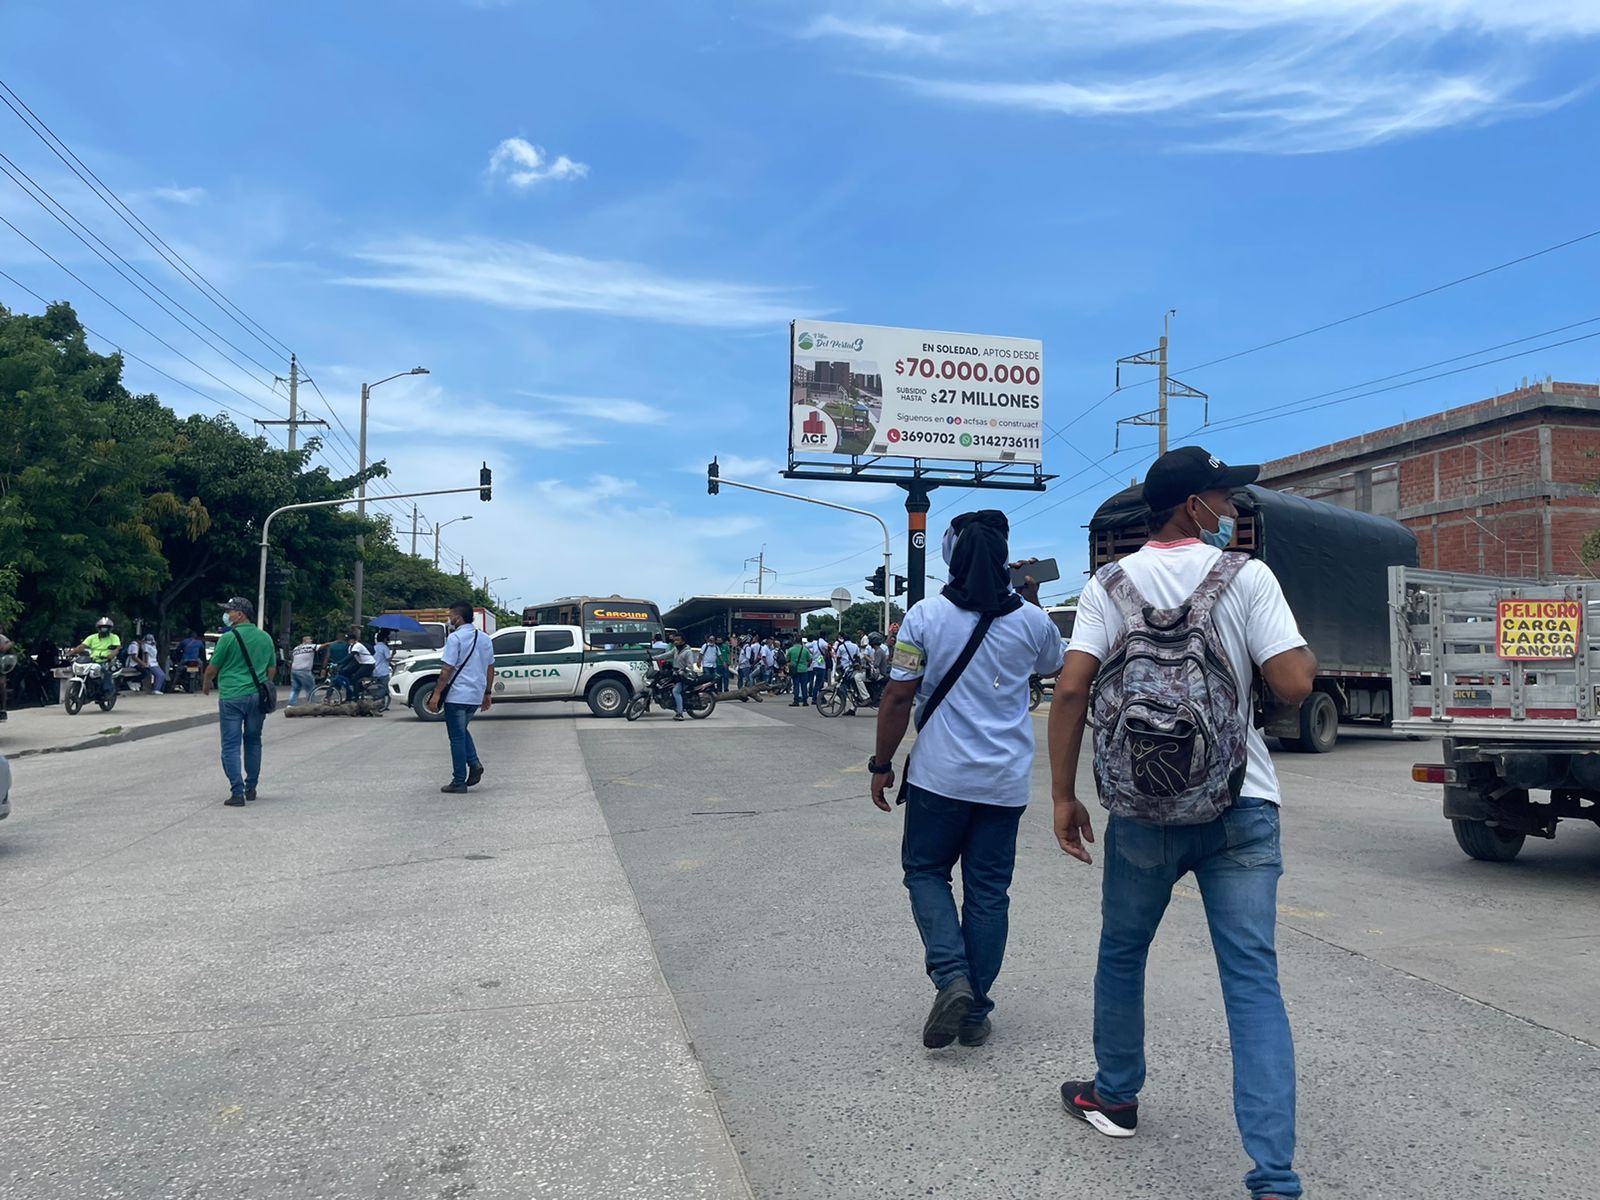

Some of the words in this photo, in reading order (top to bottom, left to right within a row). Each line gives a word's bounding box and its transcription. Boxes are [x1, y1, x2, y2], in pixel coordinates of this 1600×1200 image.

[816, 339, 829, 348] Del
[830, 340, 854, 349] Portal
[854, 338, 864, 352] 3
[923, 343, 934, 352] EN
[937, 344, 981, 357] SOLEDAD,
[983, 346, 1011, 358] APTOS
[1013, 350, 1040, 360] DESDE
[895, 357, 1040, 386] $70.000.000
[896, 386, 927, 396] SUBSIDIO
[901, 394, 923, 402] HASTA
[931, 390, 956, 405] $27
[962, 390, 1040, 409] MILLONES
[963, 418, 988, 426] acfsas
[998, 420, 1039, 429] construacf
[801, 433, 828, 444] ACF
[901, 431, 956, 444] 3690702
[973, 435, 1040, 449] 3142736111
[1501, 603, 1578, 618] PELIGRO
[1503, 619, 1571, 632] CARGA
[1502, 631, 1575, 644] LARGA
[1501, 645, 1512, 656] Y
[1516, 645, 1575, 657] ANCHA
